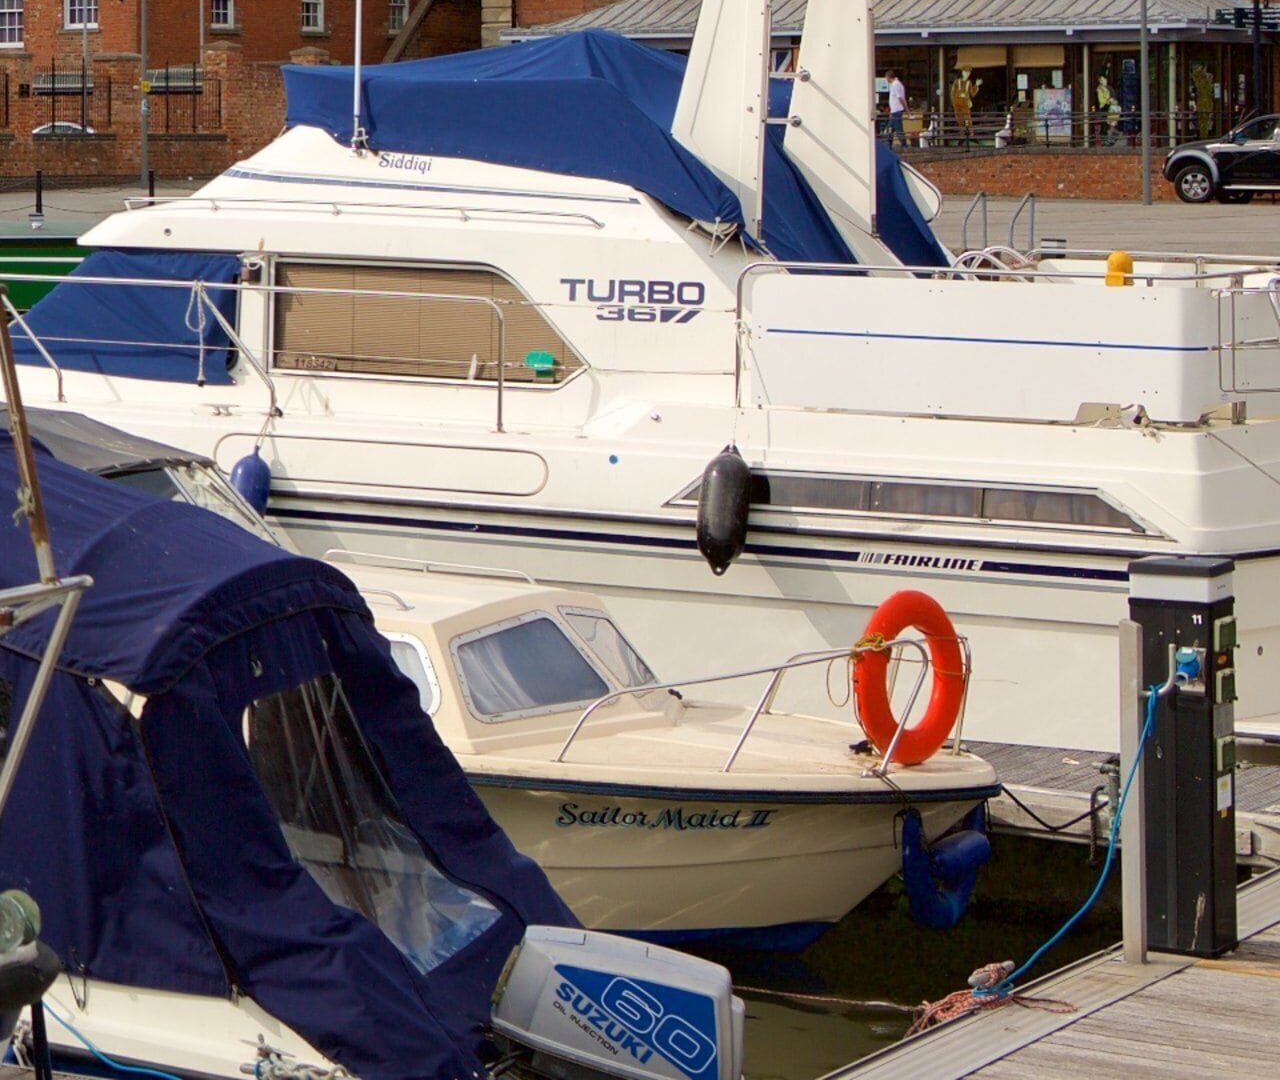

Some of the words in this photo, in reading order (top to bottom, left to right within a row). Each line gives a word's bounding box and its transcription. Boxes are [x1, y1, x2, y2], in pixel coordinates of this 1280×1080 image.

[378, 152, 433, 175] Siddiqi
[560, 278, 705, 306] TURBO
[596, 304, 657, 323] 36
[883, 553, 980, 571] FAIRLINE
[1191, 614, 1203, 625] 11
[555, 802, 648, 829] Sailor
[649, 807, 742, 831] Maid
[742, 808, 778, 829] II
[552, 1000, 567, 1016] OIL
[569, 1013, 619, 1056] INJECTION
[555, 982, 654, 1065] SUZUKI
[601, 976, 717, 1074] 60
